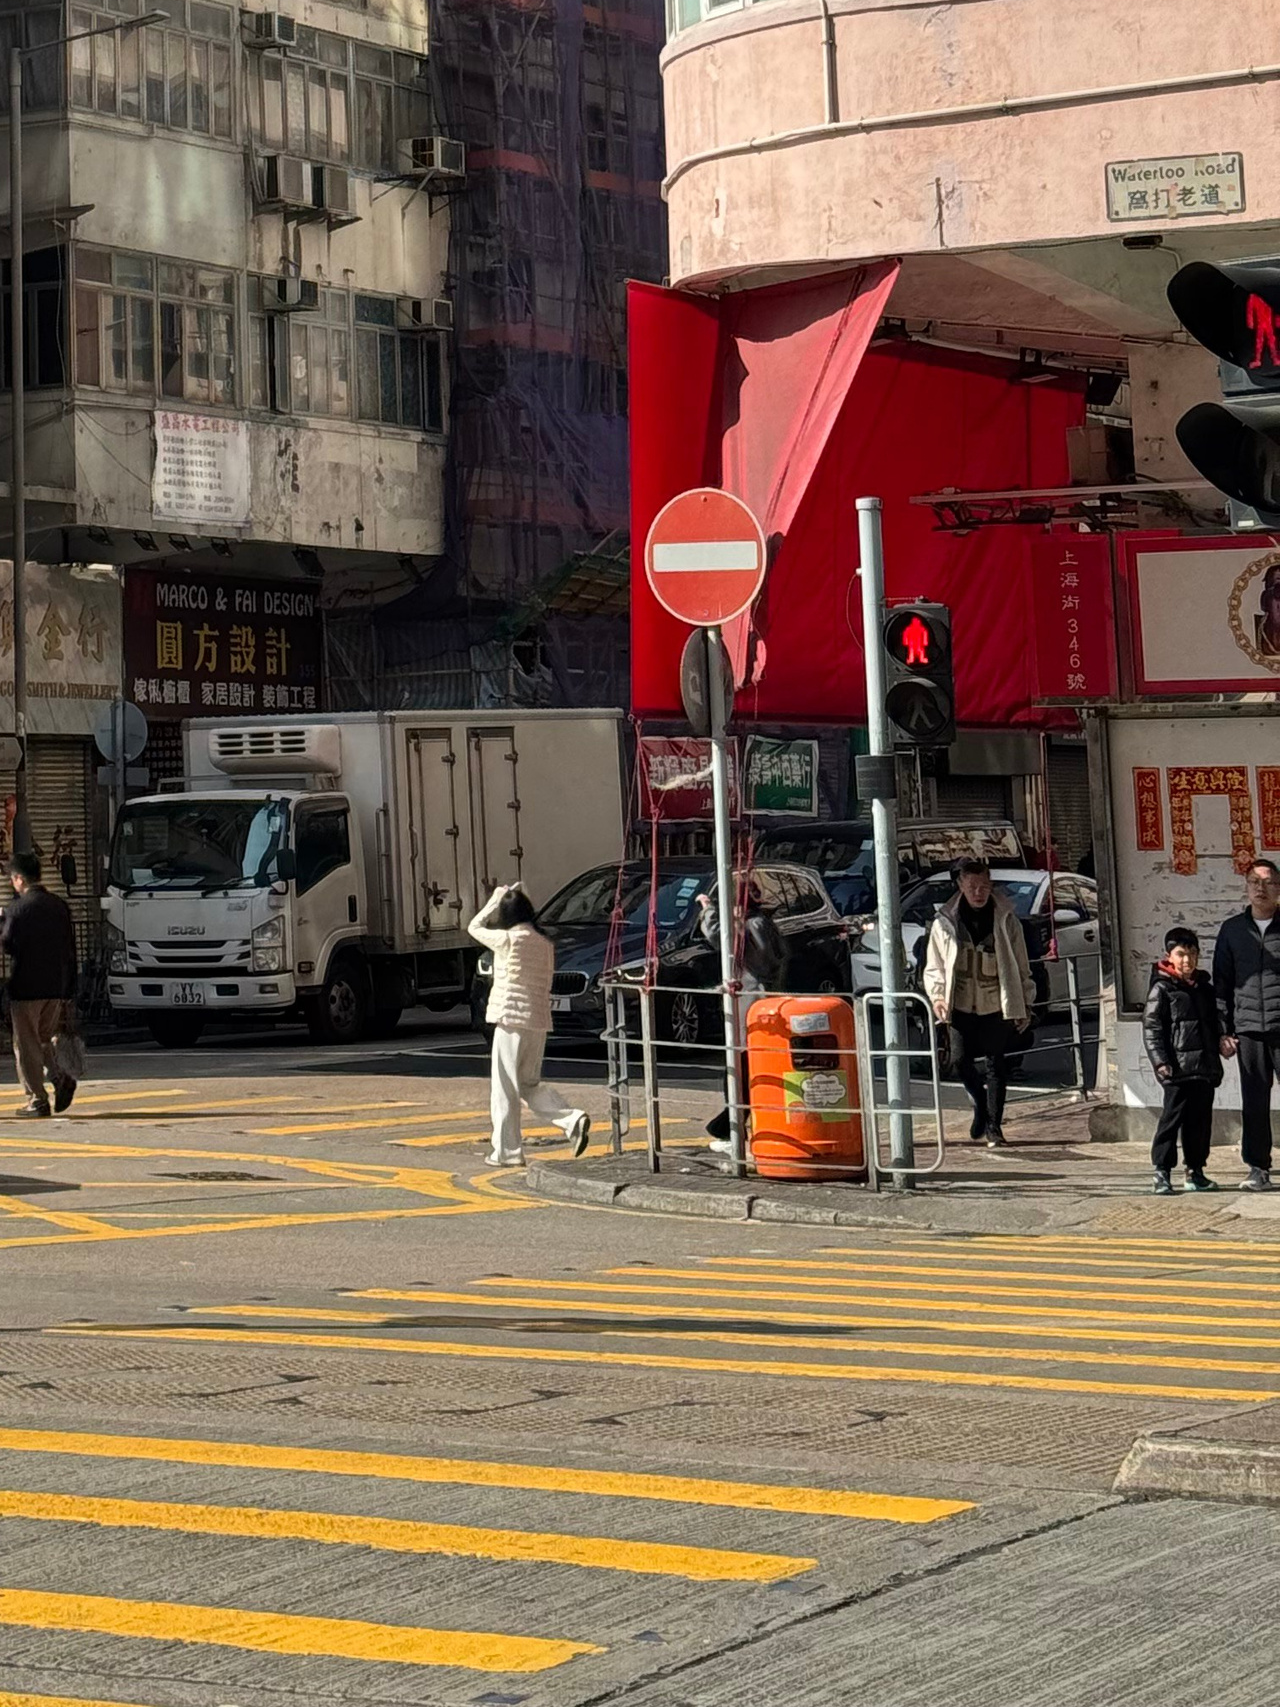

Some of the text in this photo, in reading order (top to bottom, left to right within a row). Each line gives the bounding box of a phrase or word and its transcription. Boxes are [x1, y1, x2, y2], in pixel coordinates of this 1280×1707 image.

[1111, 166, 1185, 183] Waterloo
[1127, 183, 1220, 210] 窩打老道
[156, 583, 314, 617] MARCO & FAI DESIGN
[1059, 550, 1087, 690] 上海街346號
[156, 620, 291, 676] 圓方設計
[201, 681, 255, 707] 家居設計
[167, 925, 206, 936] ISUZU
